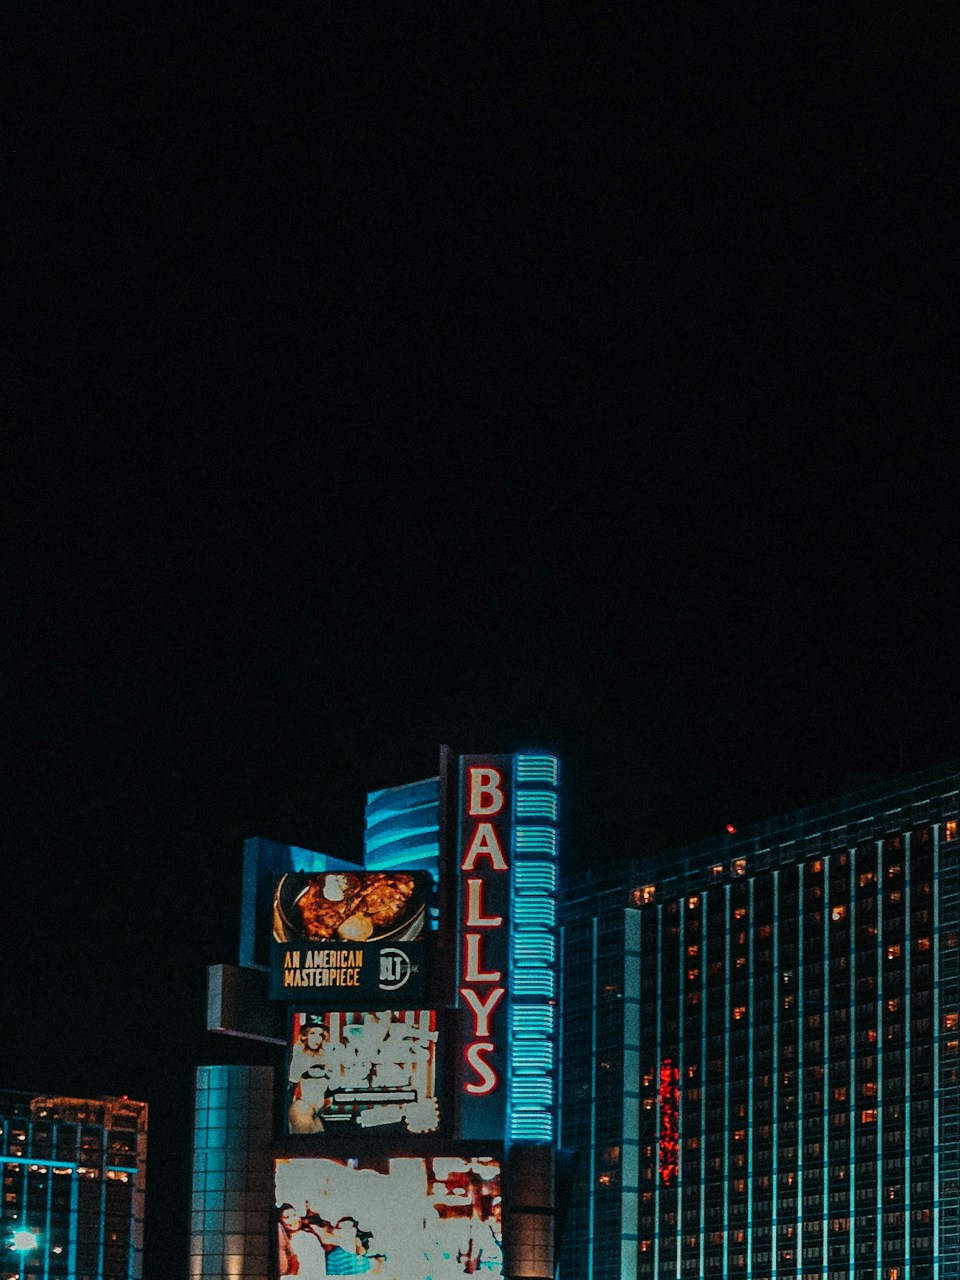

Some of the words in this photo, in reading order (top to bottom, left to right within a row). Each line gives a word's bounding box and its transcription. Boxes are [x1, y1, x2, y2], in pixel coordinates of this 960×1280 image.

[460, 767, 509, 1094] BALLYS
[284, 951, 300, 968] AN
[304, 950, 363, 968] AMERICAN
[284, 968, 361, 987] MASTERPIECE
